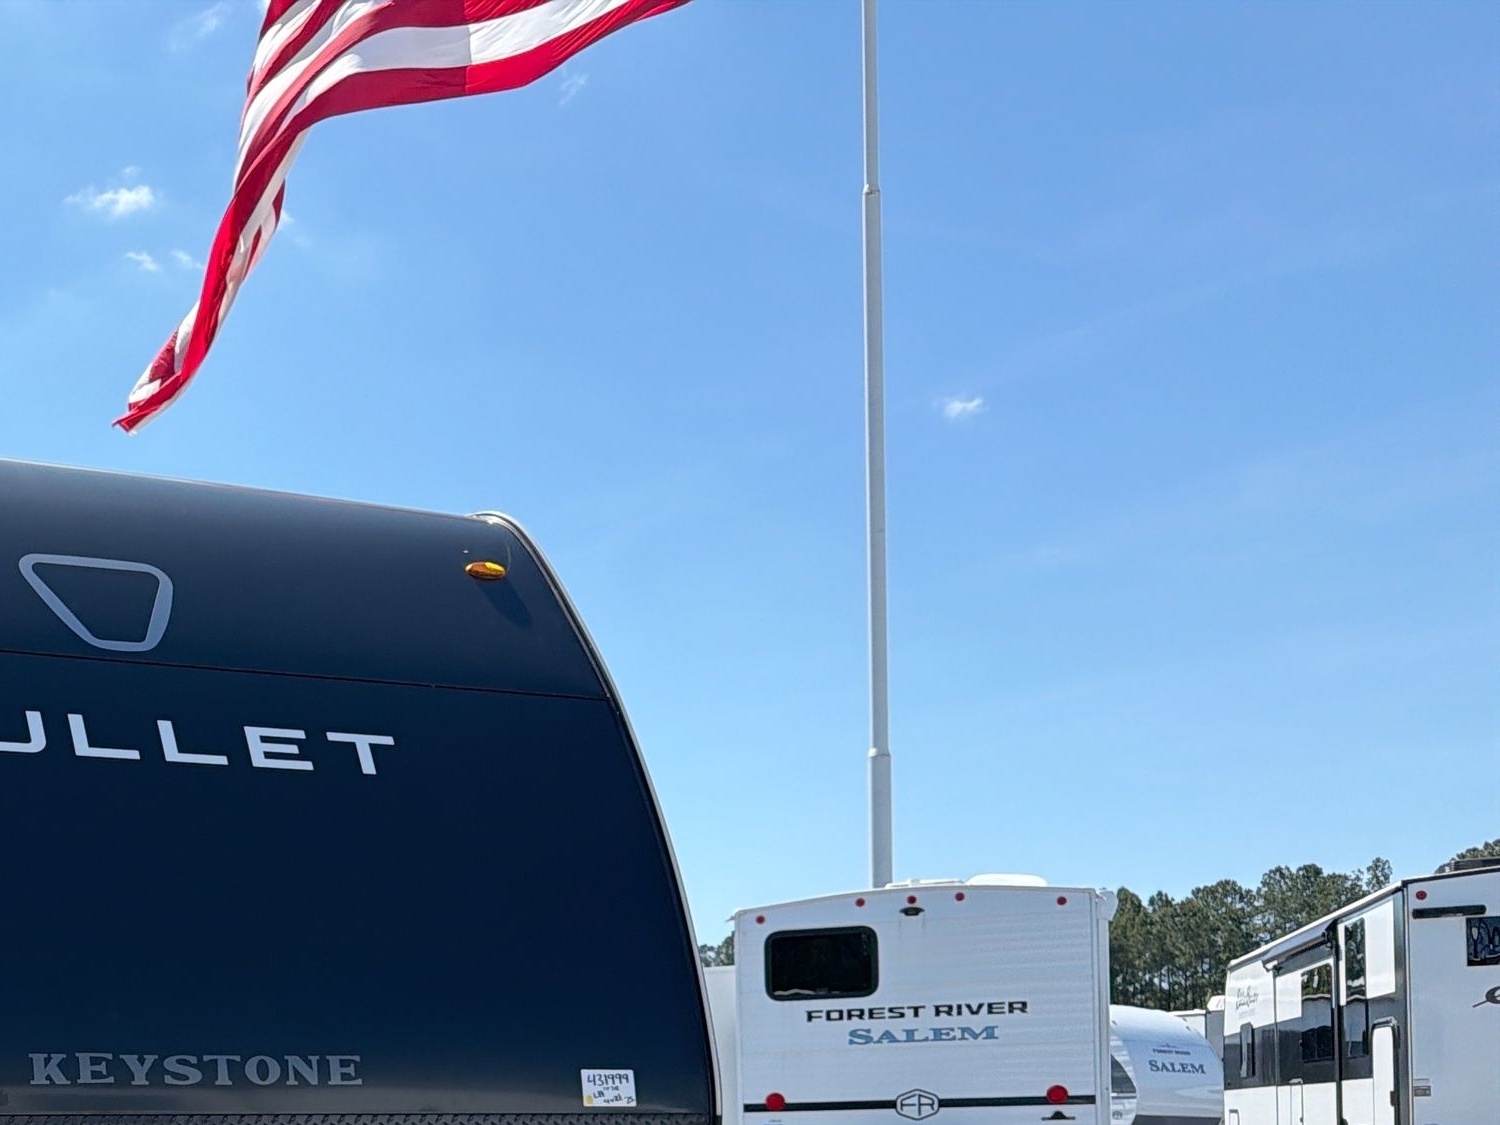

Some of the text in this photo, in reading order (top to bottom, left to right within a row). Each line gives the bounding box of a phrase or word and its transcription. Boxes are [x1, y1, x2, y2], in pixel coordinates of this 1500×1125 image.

[806, 1000, 1028, 1023] FOREST RIVER
[848, 1025, 999, 1046] SALEM
[28, 1051, 363, 1087] KEYSTONE
[1148, 1059, 1206, 1074] SALEM
[587, 1072, 630, 1087] 431999
